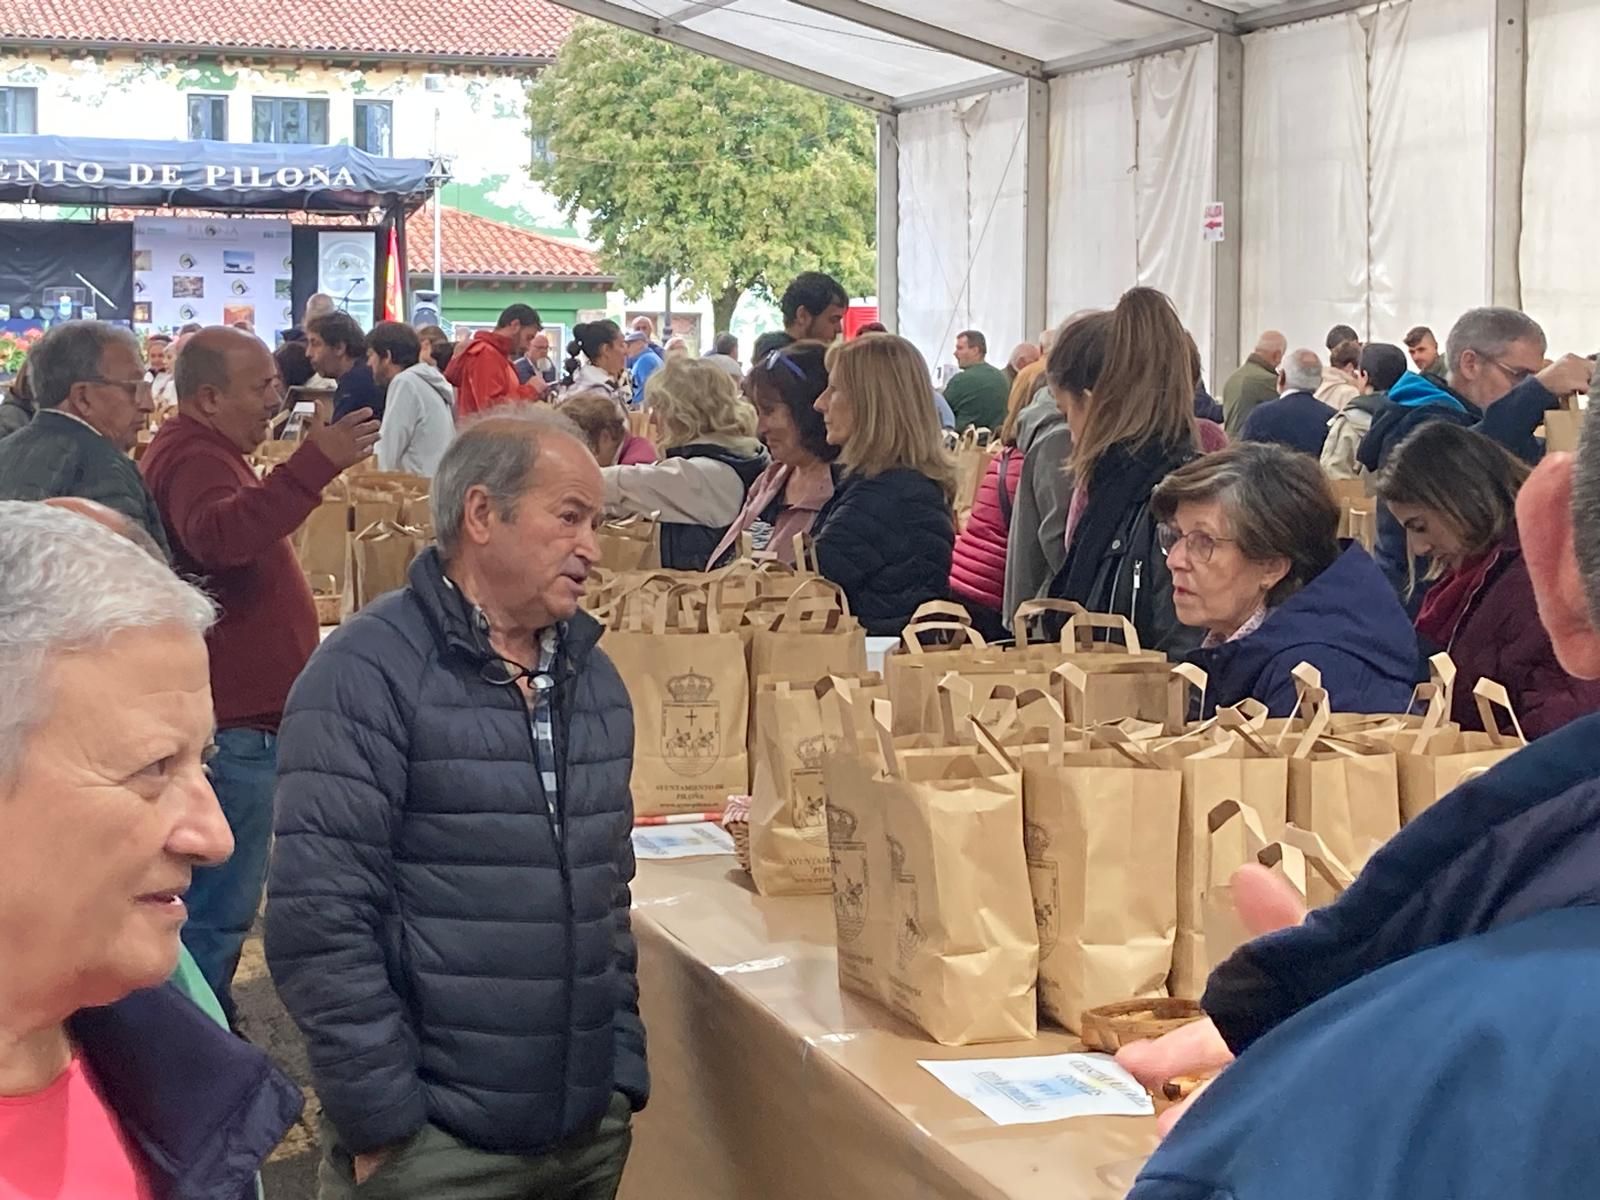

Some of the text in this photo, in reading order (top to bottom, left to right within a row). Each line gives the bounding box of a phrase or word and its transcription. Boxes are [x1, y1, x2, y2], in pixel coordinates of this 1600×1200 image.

[128, 162, 183, 186] DE
[206, 164, 357, 188] PILOÑA
[655, 784, 714, 792] AYUNTAMIENTO
